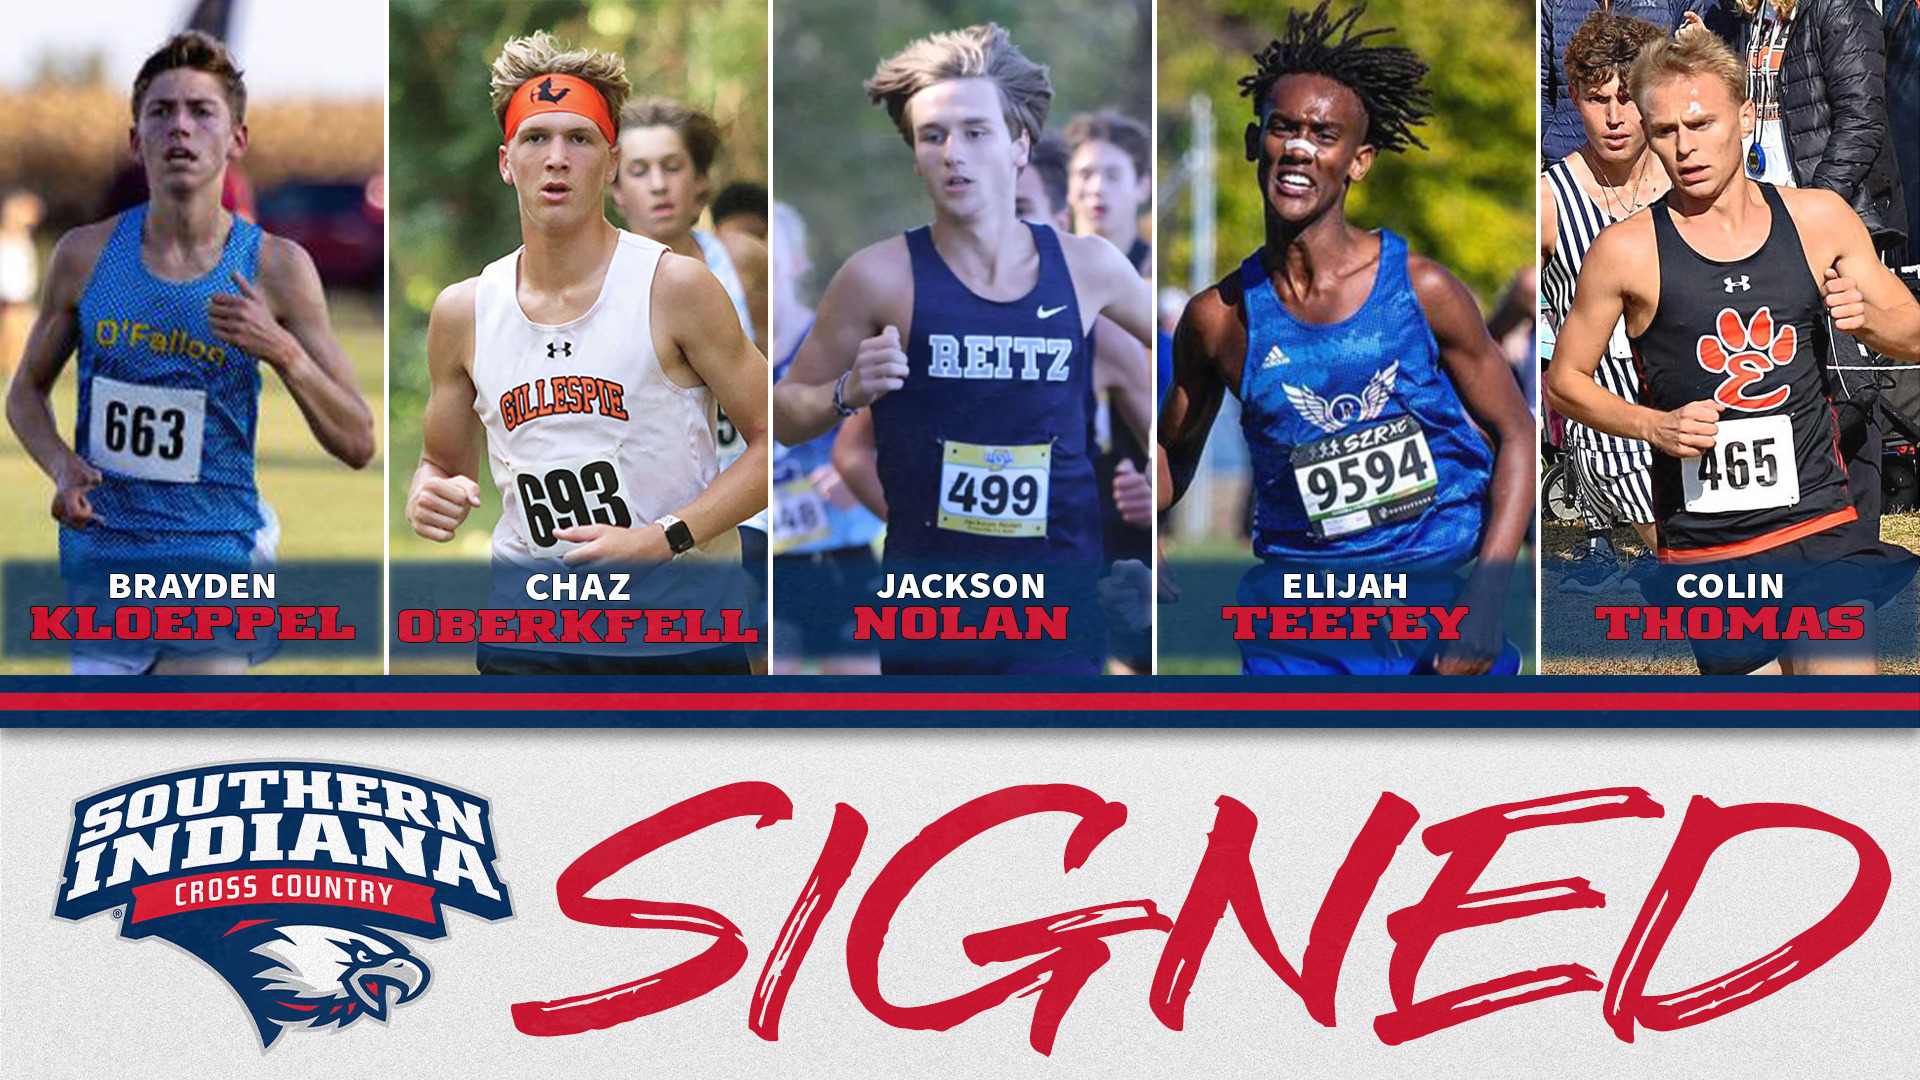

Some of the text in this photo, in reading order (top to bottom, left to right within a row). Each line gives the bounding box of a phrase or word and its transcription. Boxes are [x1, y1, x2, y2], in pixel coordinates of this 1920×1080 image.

[97, 319, 226, 368] O'Fallon
[928, 333, 1074, 382] REITZ
[105, 400, 185, 461] 663
[500, 375, 630, 432] GILLESPIE
[1307, 438, 1428, 511] 9594
[1698, 437, 1777, 491] 465
[516, 460, 633, 548] 693
[947, 471, 1039, 517] 499
